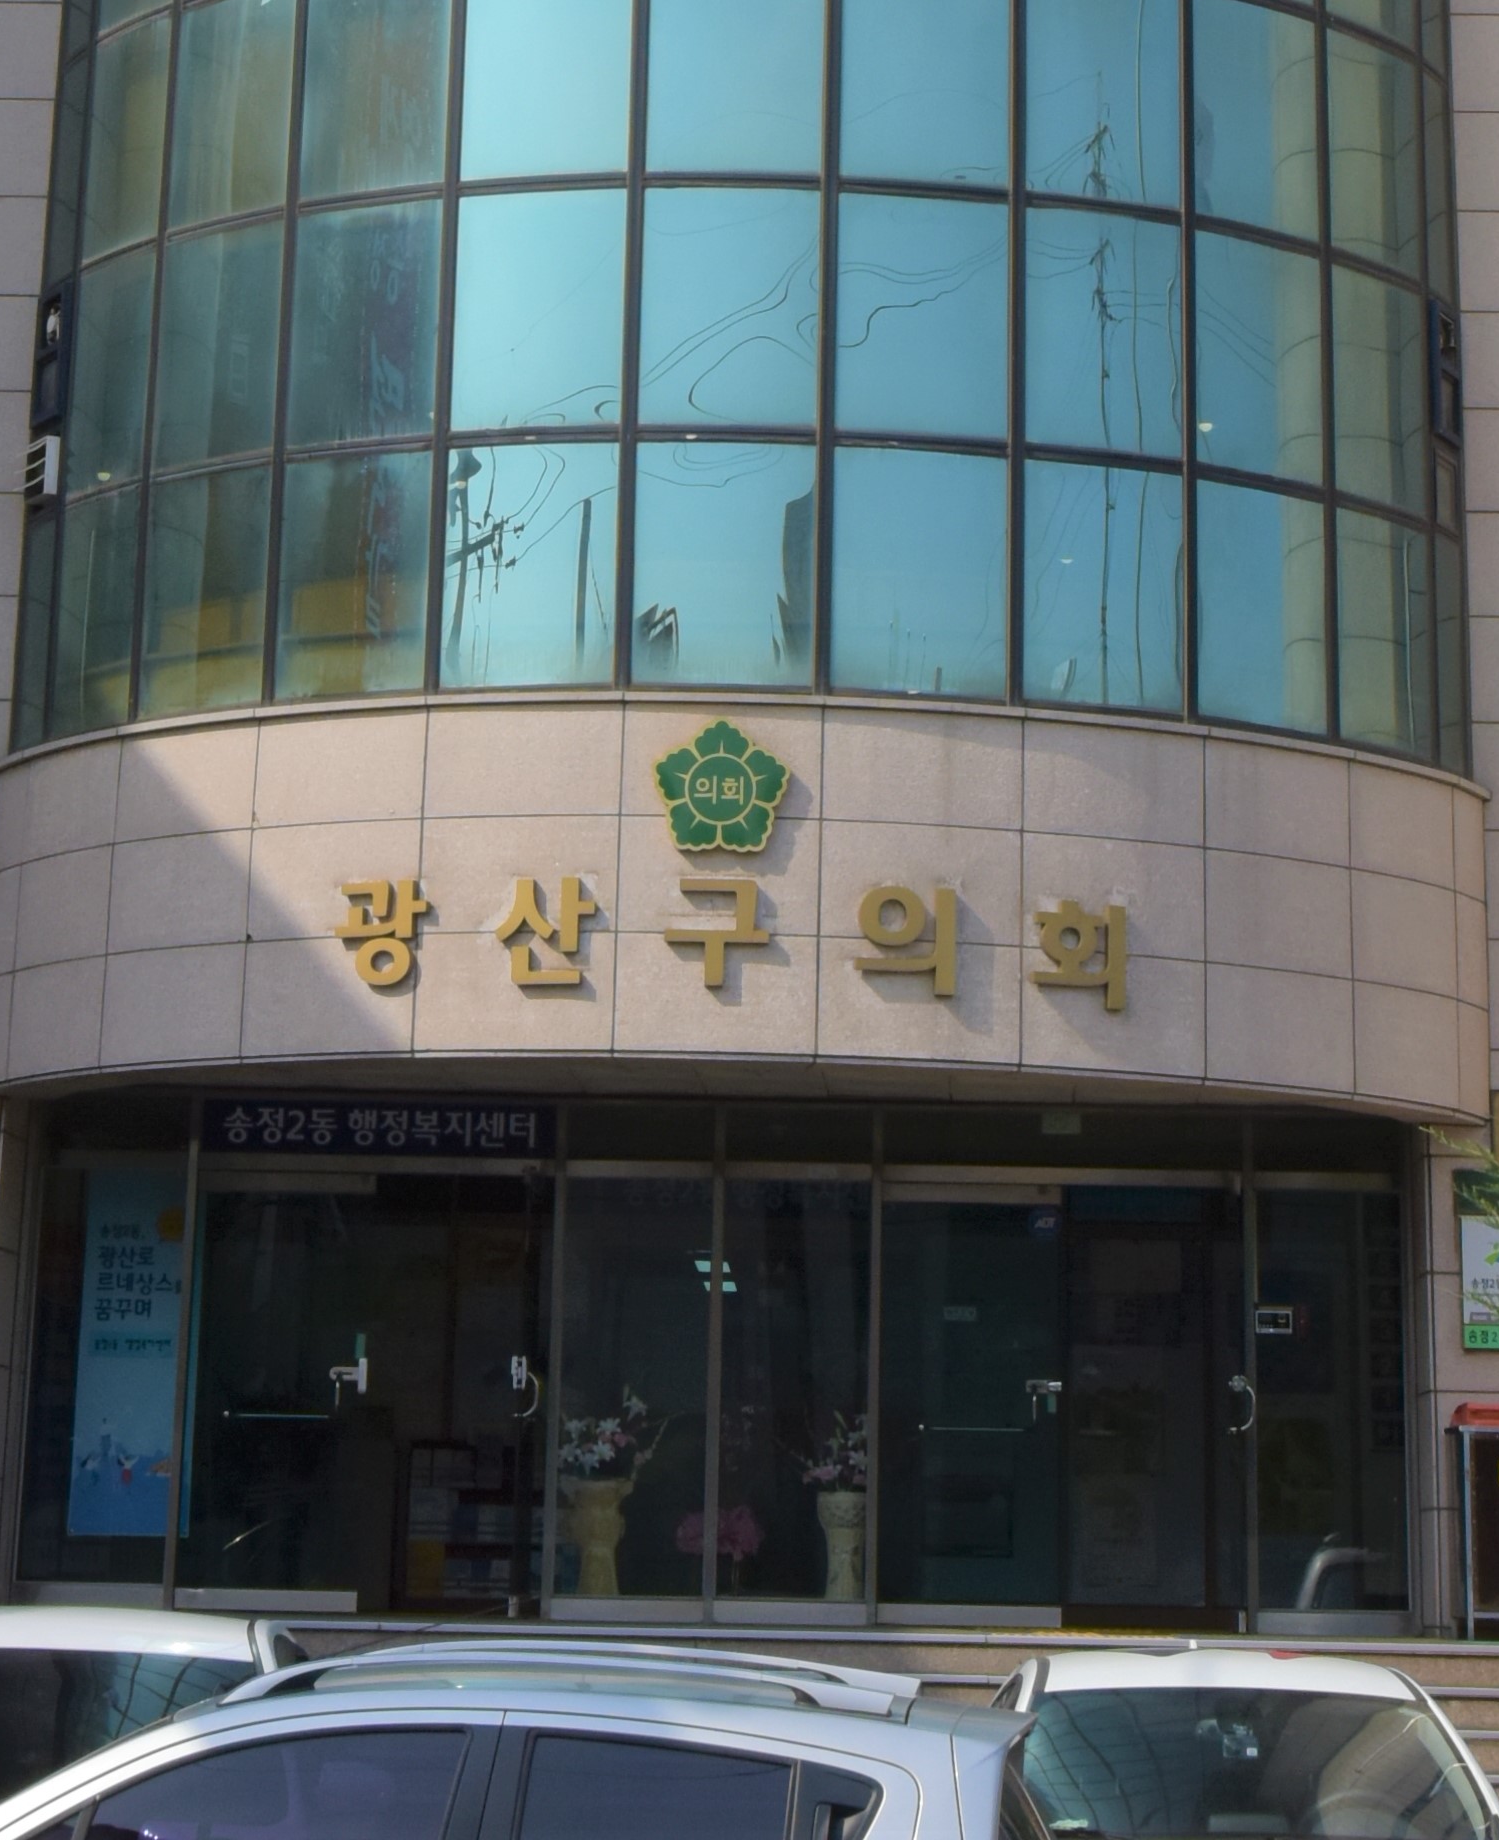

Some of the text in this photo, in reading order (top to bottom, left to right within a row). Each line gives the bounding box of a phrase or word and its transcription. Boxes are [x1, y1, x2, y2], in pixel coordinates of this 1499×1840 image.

[693, 775, 744, 806] 의회
[223, 1106, 538, 1150] 송정2동 행정복지센터
[98, 1246, 155, 1269] 광산로
